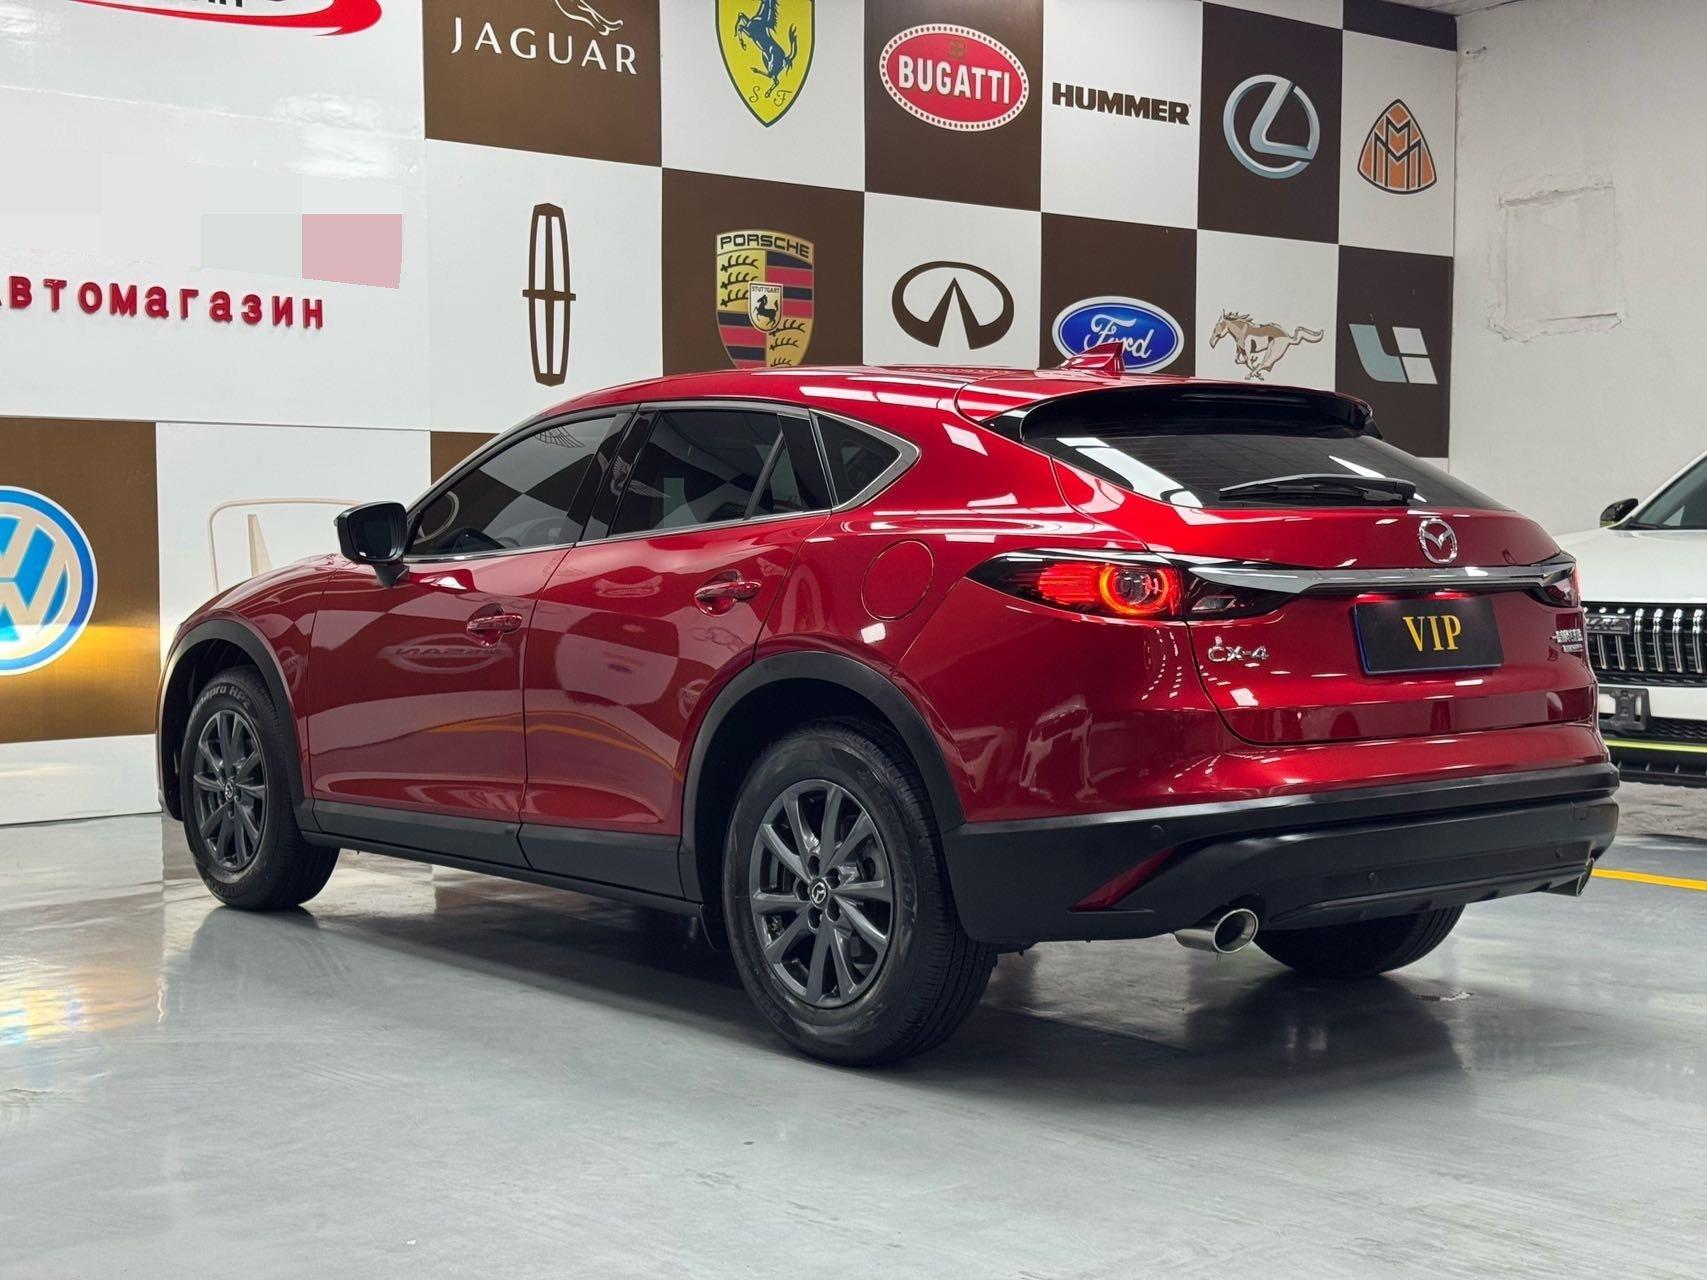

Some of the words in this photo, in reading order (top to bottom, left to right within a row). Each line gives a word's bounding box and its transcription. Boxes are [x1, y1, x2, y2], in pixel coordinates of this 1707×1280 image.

[451, 17, 638, 75] JAGUAR
[898, 54, 1011, 105] BUGATTI
[1052, 82, 1190, 125] HUMMER
[719, 233, 810, 259] PORSCHE
[0, 275, 324, 330] втомагазин
[751, 286, 780, 294] STUTTGART
[1084, 313, 1155, 358] Frd
[1207, 644, 1270, 662] CX-4
[1402, 614, 1462, 652] VIP
